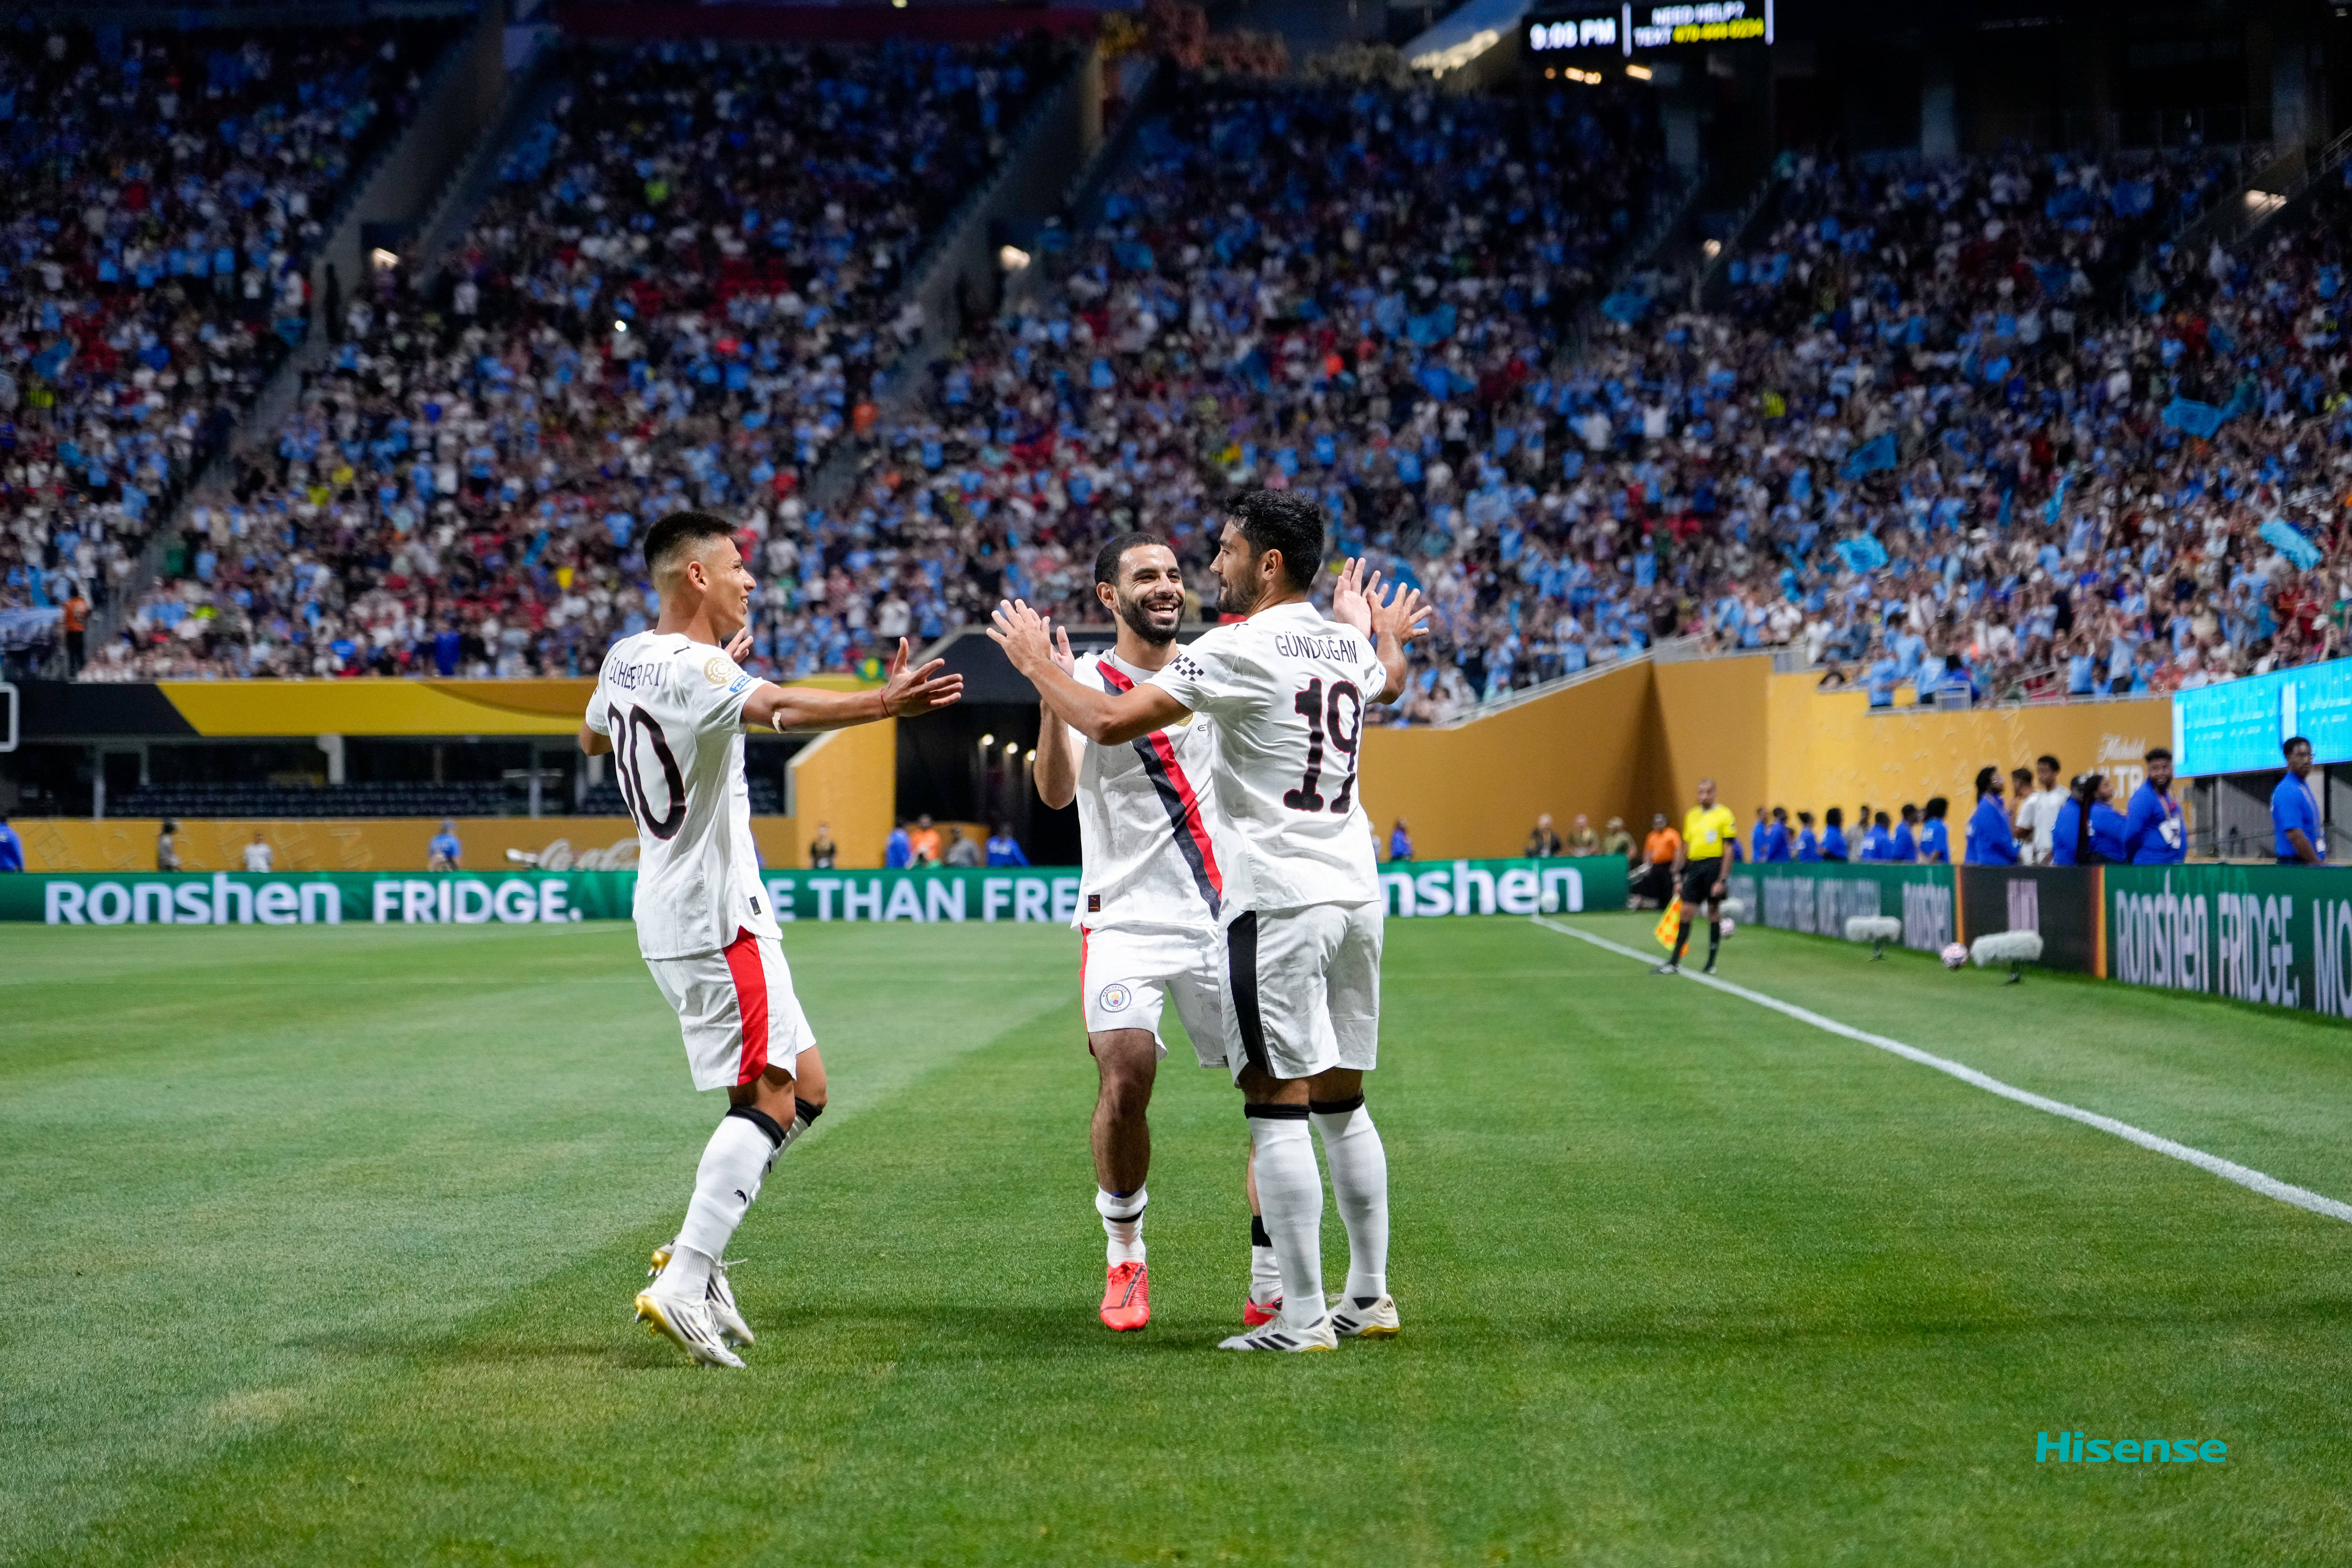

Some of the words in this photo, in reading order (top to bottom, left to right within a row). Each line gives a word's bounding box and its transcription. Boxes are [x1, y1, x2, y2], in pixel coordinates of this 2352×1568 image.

[1580, 17, 1616, 47] PM
[1275, 631, 1359, 664] GÜNDOĞAN
[1283, 677, 1361, 814] 19
[45, 871, 342, 925] Ronshen
[373, 878, 582, 923] FRIDGE.
[808, 878, 967, 923] THAN
[983, 878, 1081, 923] FRE
[1379, 860, 1584, 917] nshen
[2114, 869, 2210, 993] Ronshen
[1103, 986, 1127, 997] MANCHESTER
